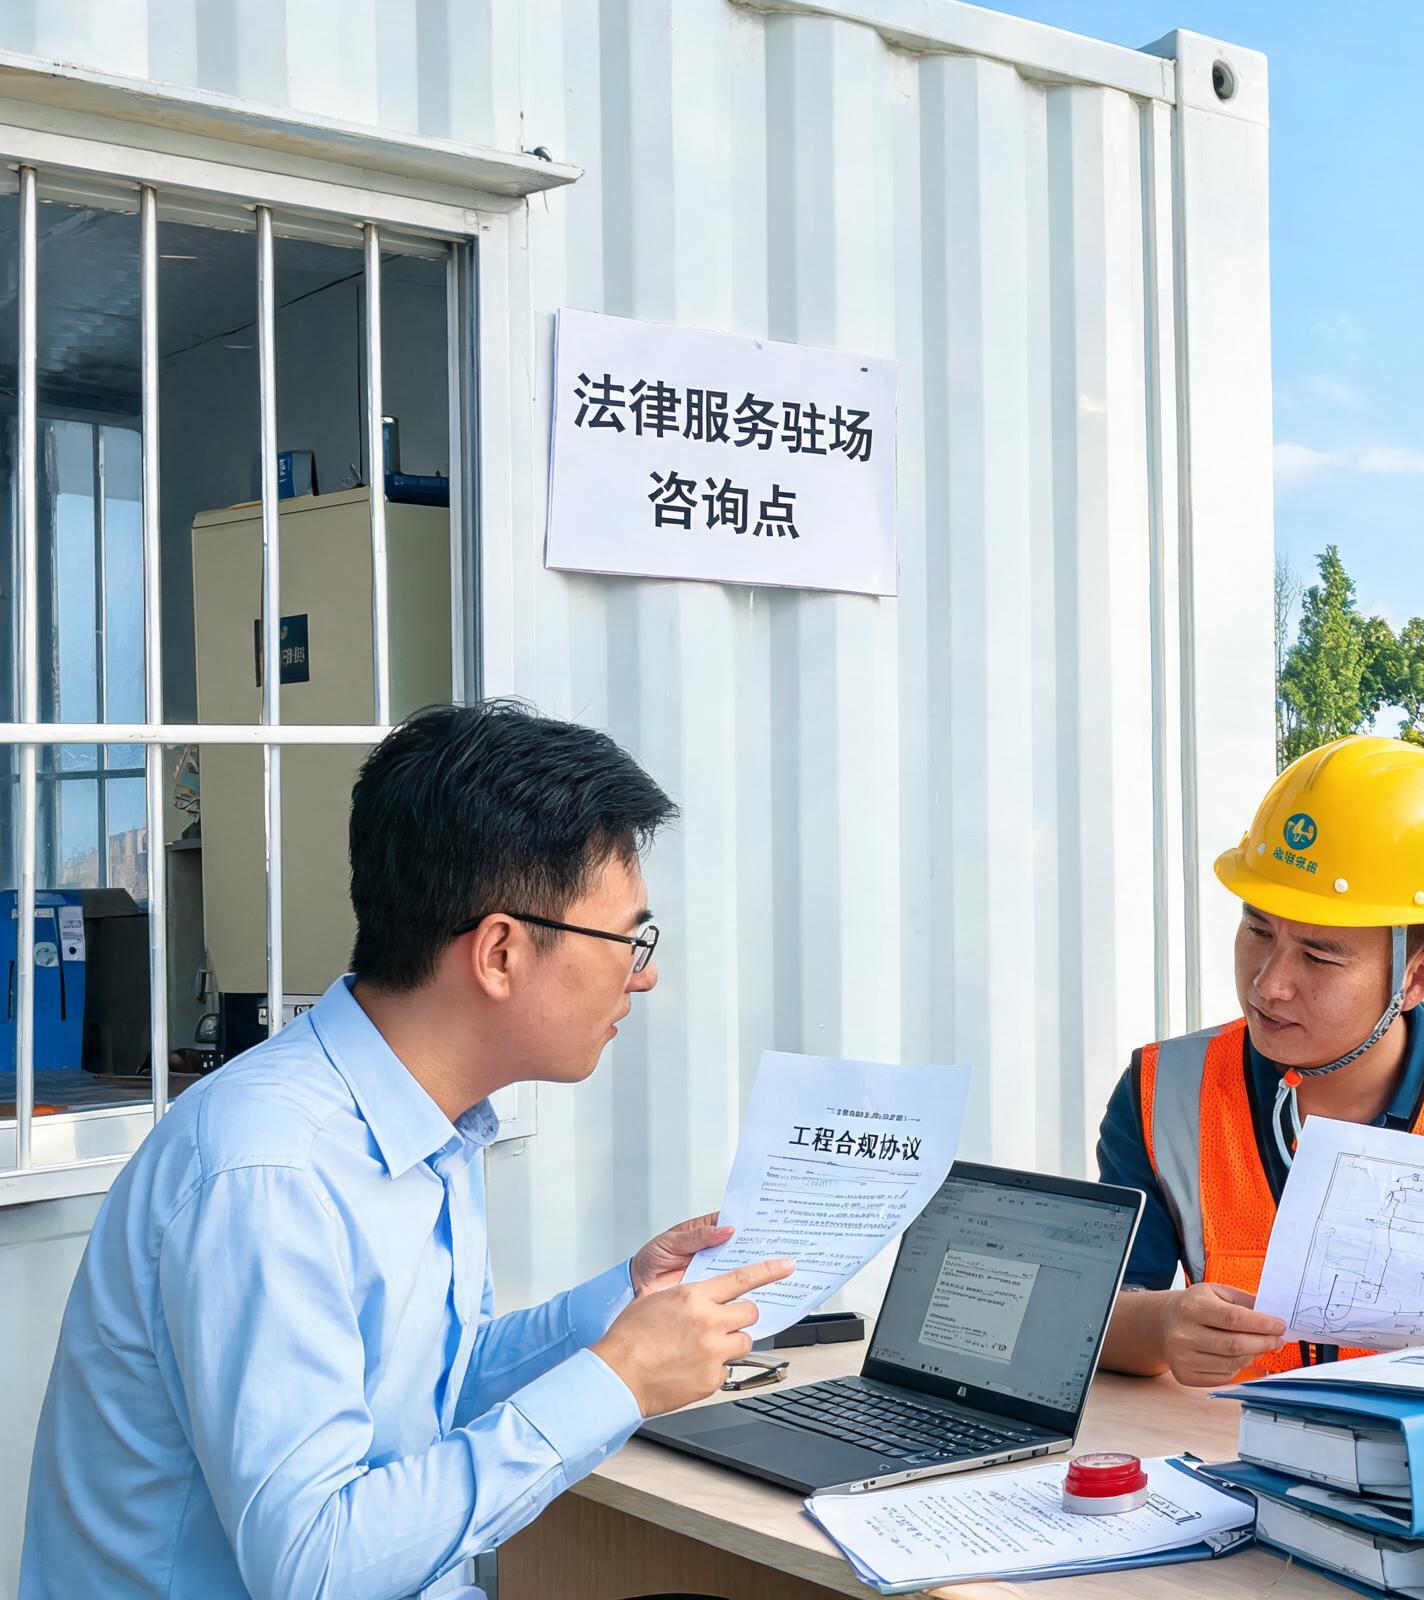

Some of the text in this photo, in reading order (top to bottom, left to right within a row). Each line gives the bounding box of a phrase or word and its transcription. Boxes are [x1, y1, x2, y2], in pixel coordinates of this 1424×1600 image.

[573, 372, 873, 462] 法律服务驻场
[648, 470, 800, 539] 咨询点
[788, 1125, 922, 1161] 工程合规协议
